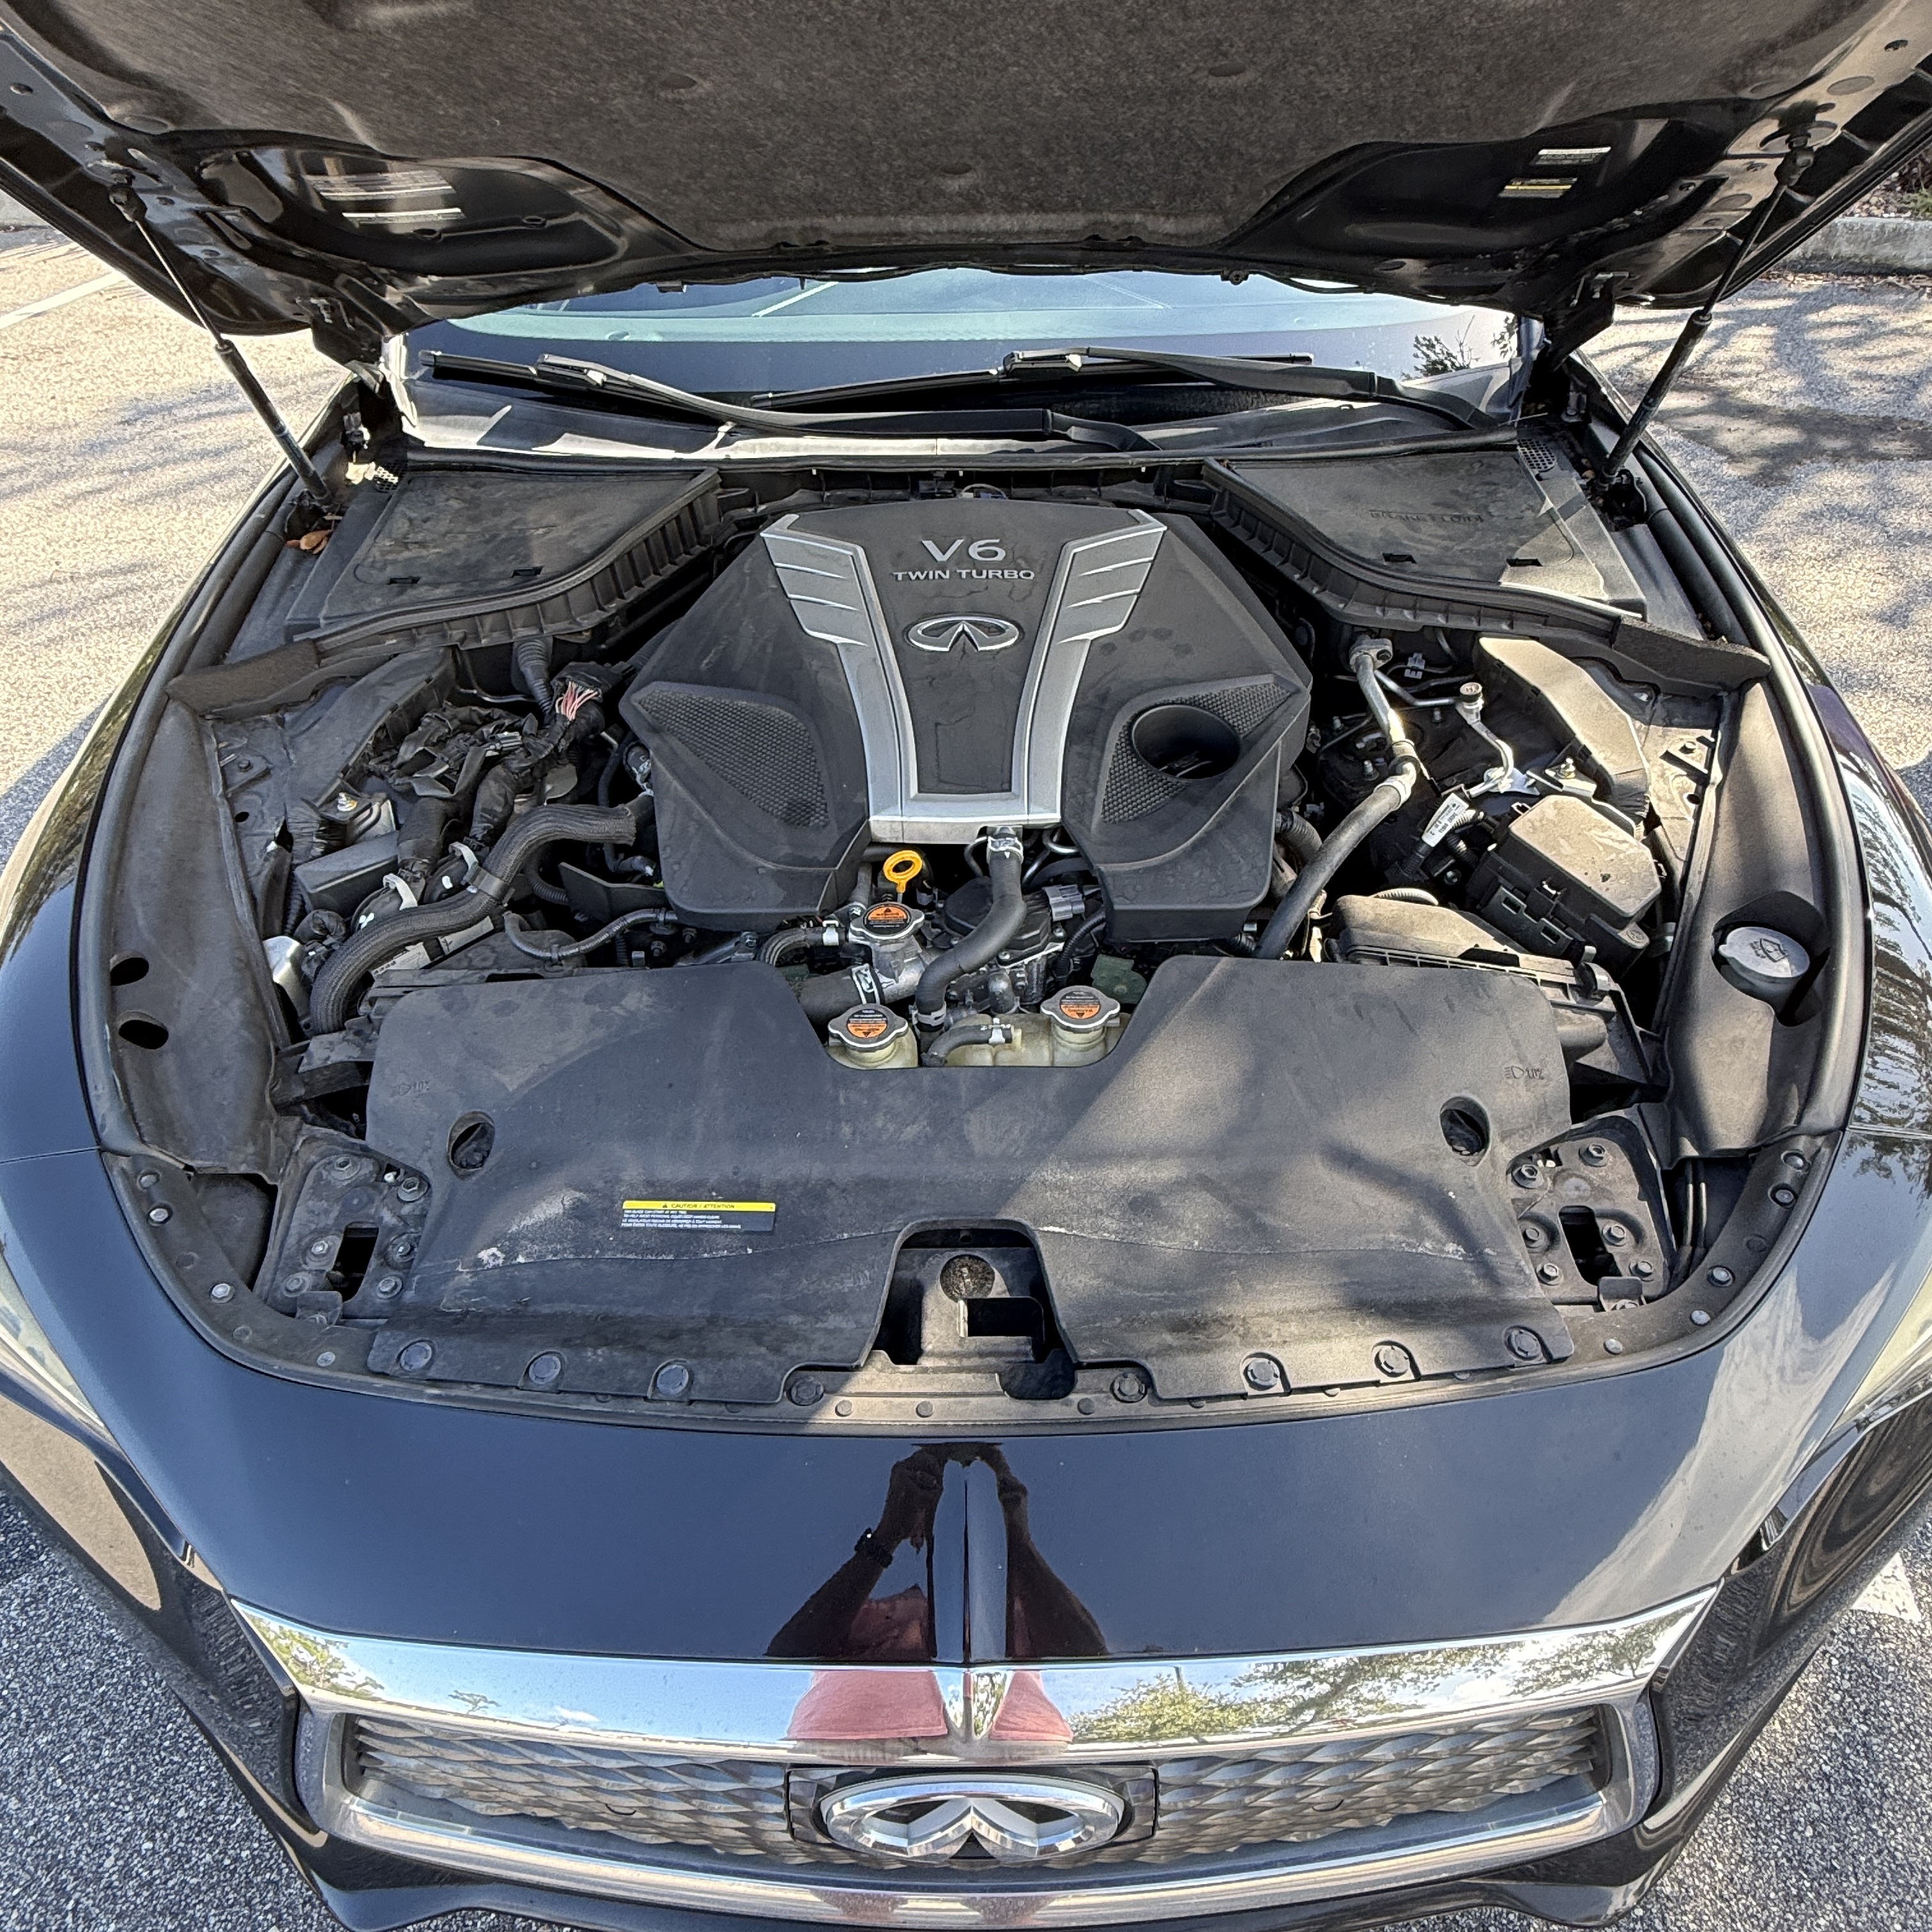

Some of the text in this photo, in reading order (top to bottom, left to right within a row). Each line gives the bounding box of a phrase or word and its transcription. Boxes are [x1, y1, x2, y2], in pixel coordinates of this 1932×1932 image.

[921, 539, 1006, 562] V6
[893, 569, 1035, 581] TWIN TURBO
